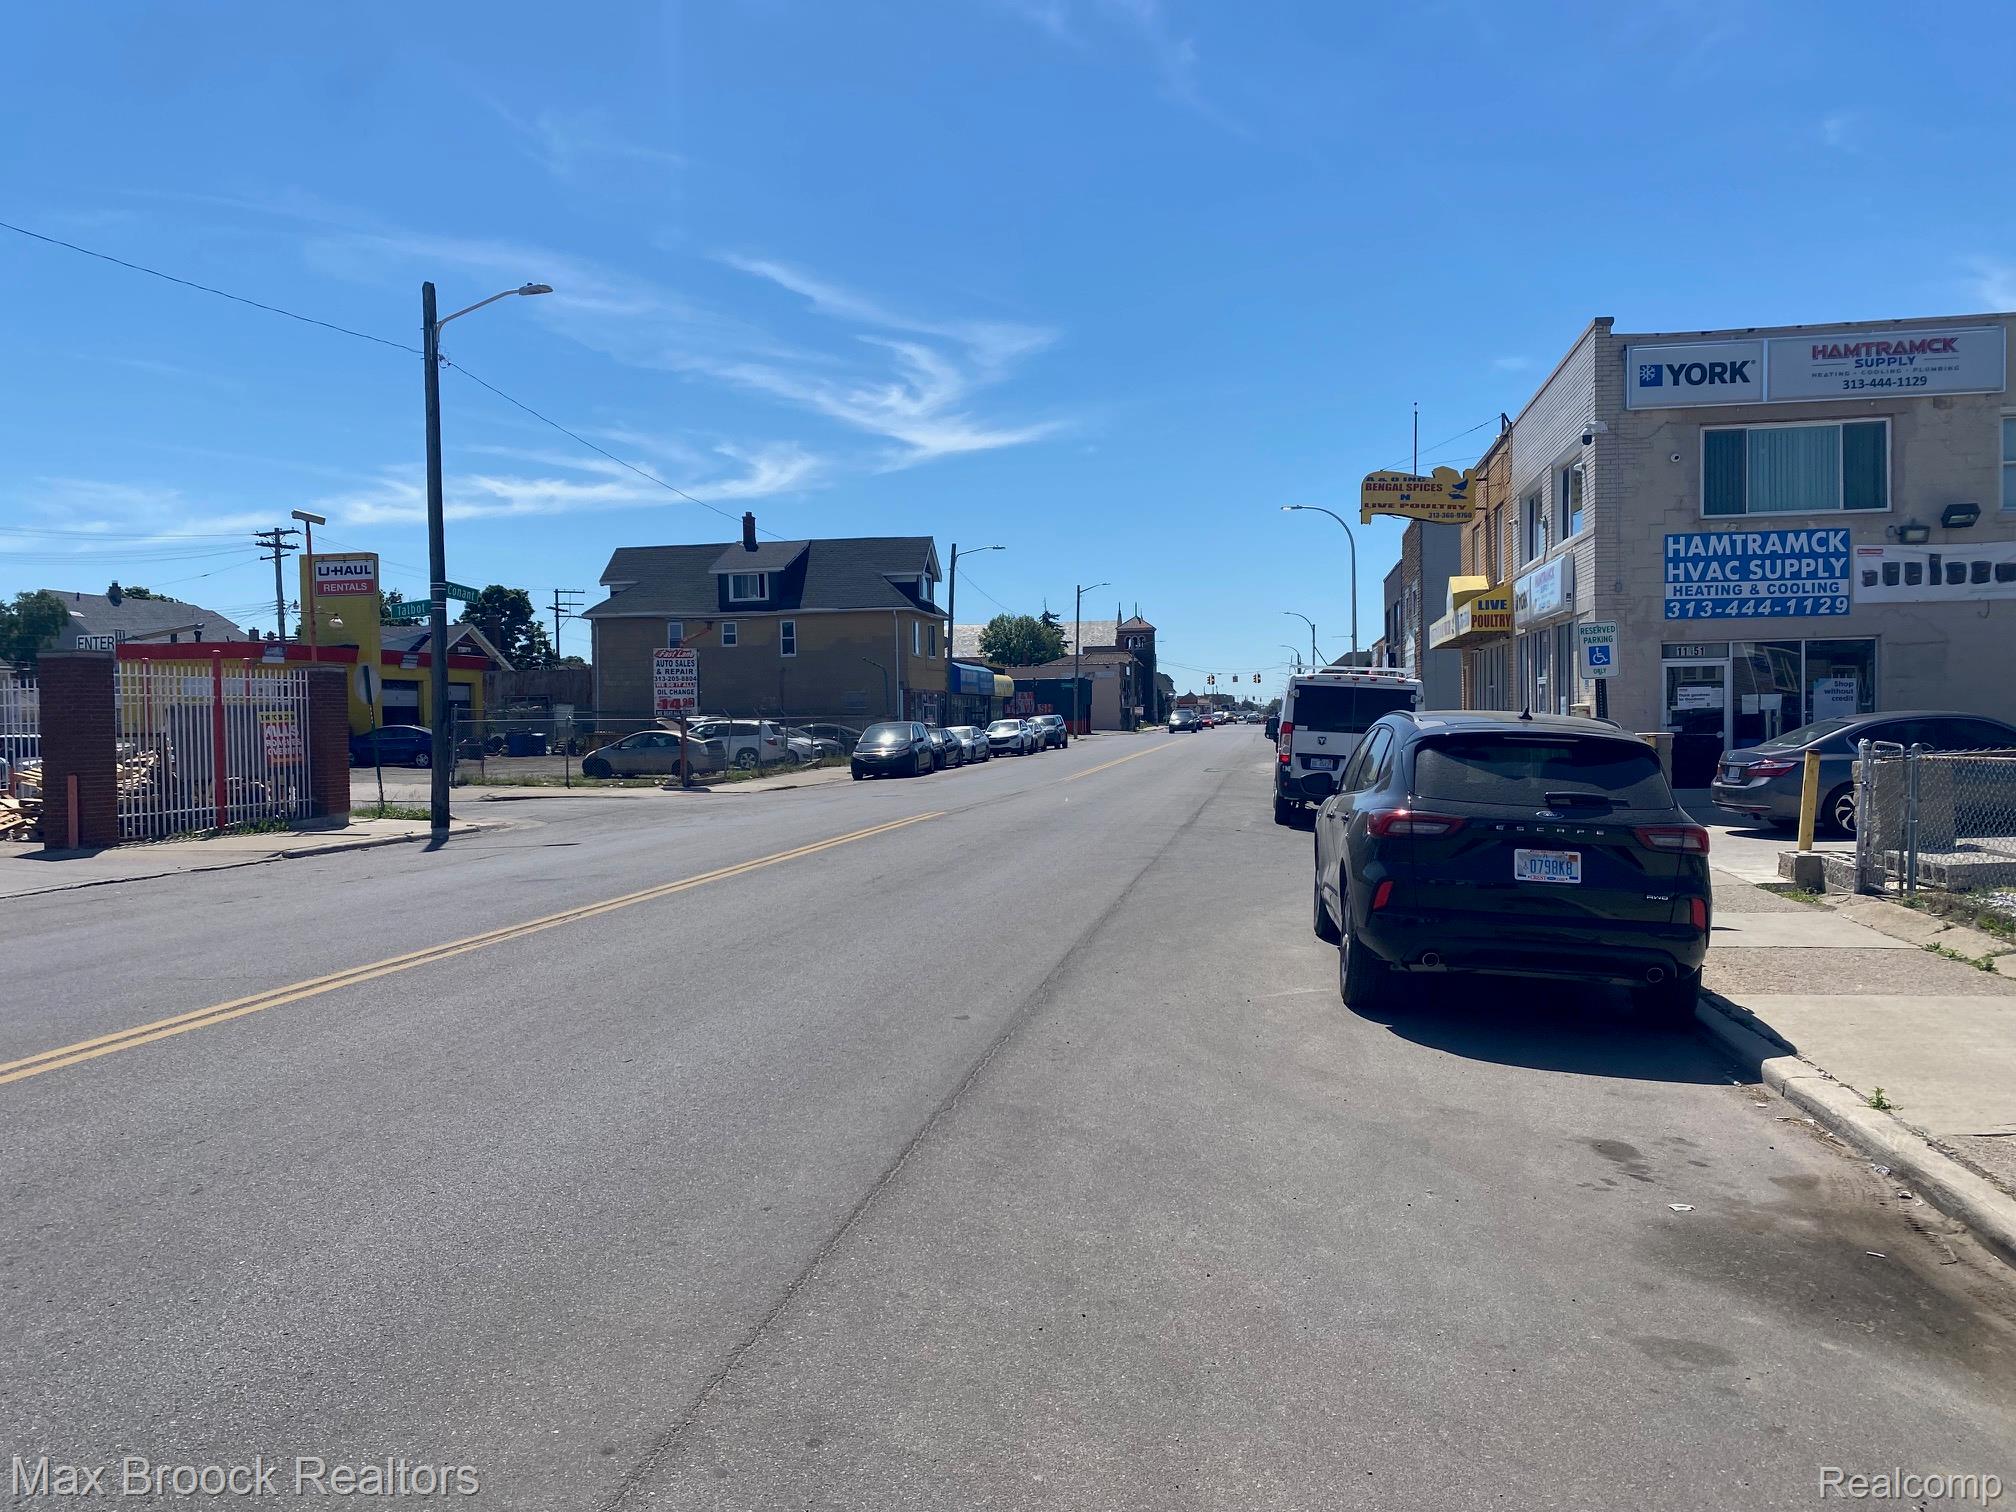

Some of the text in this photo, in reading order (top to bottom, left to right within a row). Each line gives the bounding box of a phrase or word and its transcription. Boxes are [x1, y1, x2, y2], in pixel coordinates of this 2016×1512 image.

[1812, 337, 1960, 360] HAMTRAMCK
[1854, 356, 1916, 369] SUPPLY
[1666, 360, 1751, 386] YORK
[1842, 376, 1928, 390] 313-444-1129
[1365, 483, 1443, 492] BENGAL SPICES
[1667, 531, 1847, 557] HAMTRAMCK
[318, 565, 372, 576] U-HAUL
[1667, 558, 1847, 582] HVAC SUPPLY
[323, 583, 368, 592] RENTALS
[447, 584, 475, 601] Conant
[1673, 582, 1840, 597] HEATING & COOLING
[397, 602, 425, 616] Talbot
[1477, 600, 1508, 610] LIVE
[1667, 597, 1848, 618] 313-444-1129
[1472, 613, 1511, 628] POULTRY
[1580, 625, 1616, 636] RESERVED
[78, 636, 115, 650] ENTER
[1583, 635, 1613, 644] PARKING
[656, 660, 695, 668] AUTO SALES
[1496, 825, 1604, 835] ESCAPE
